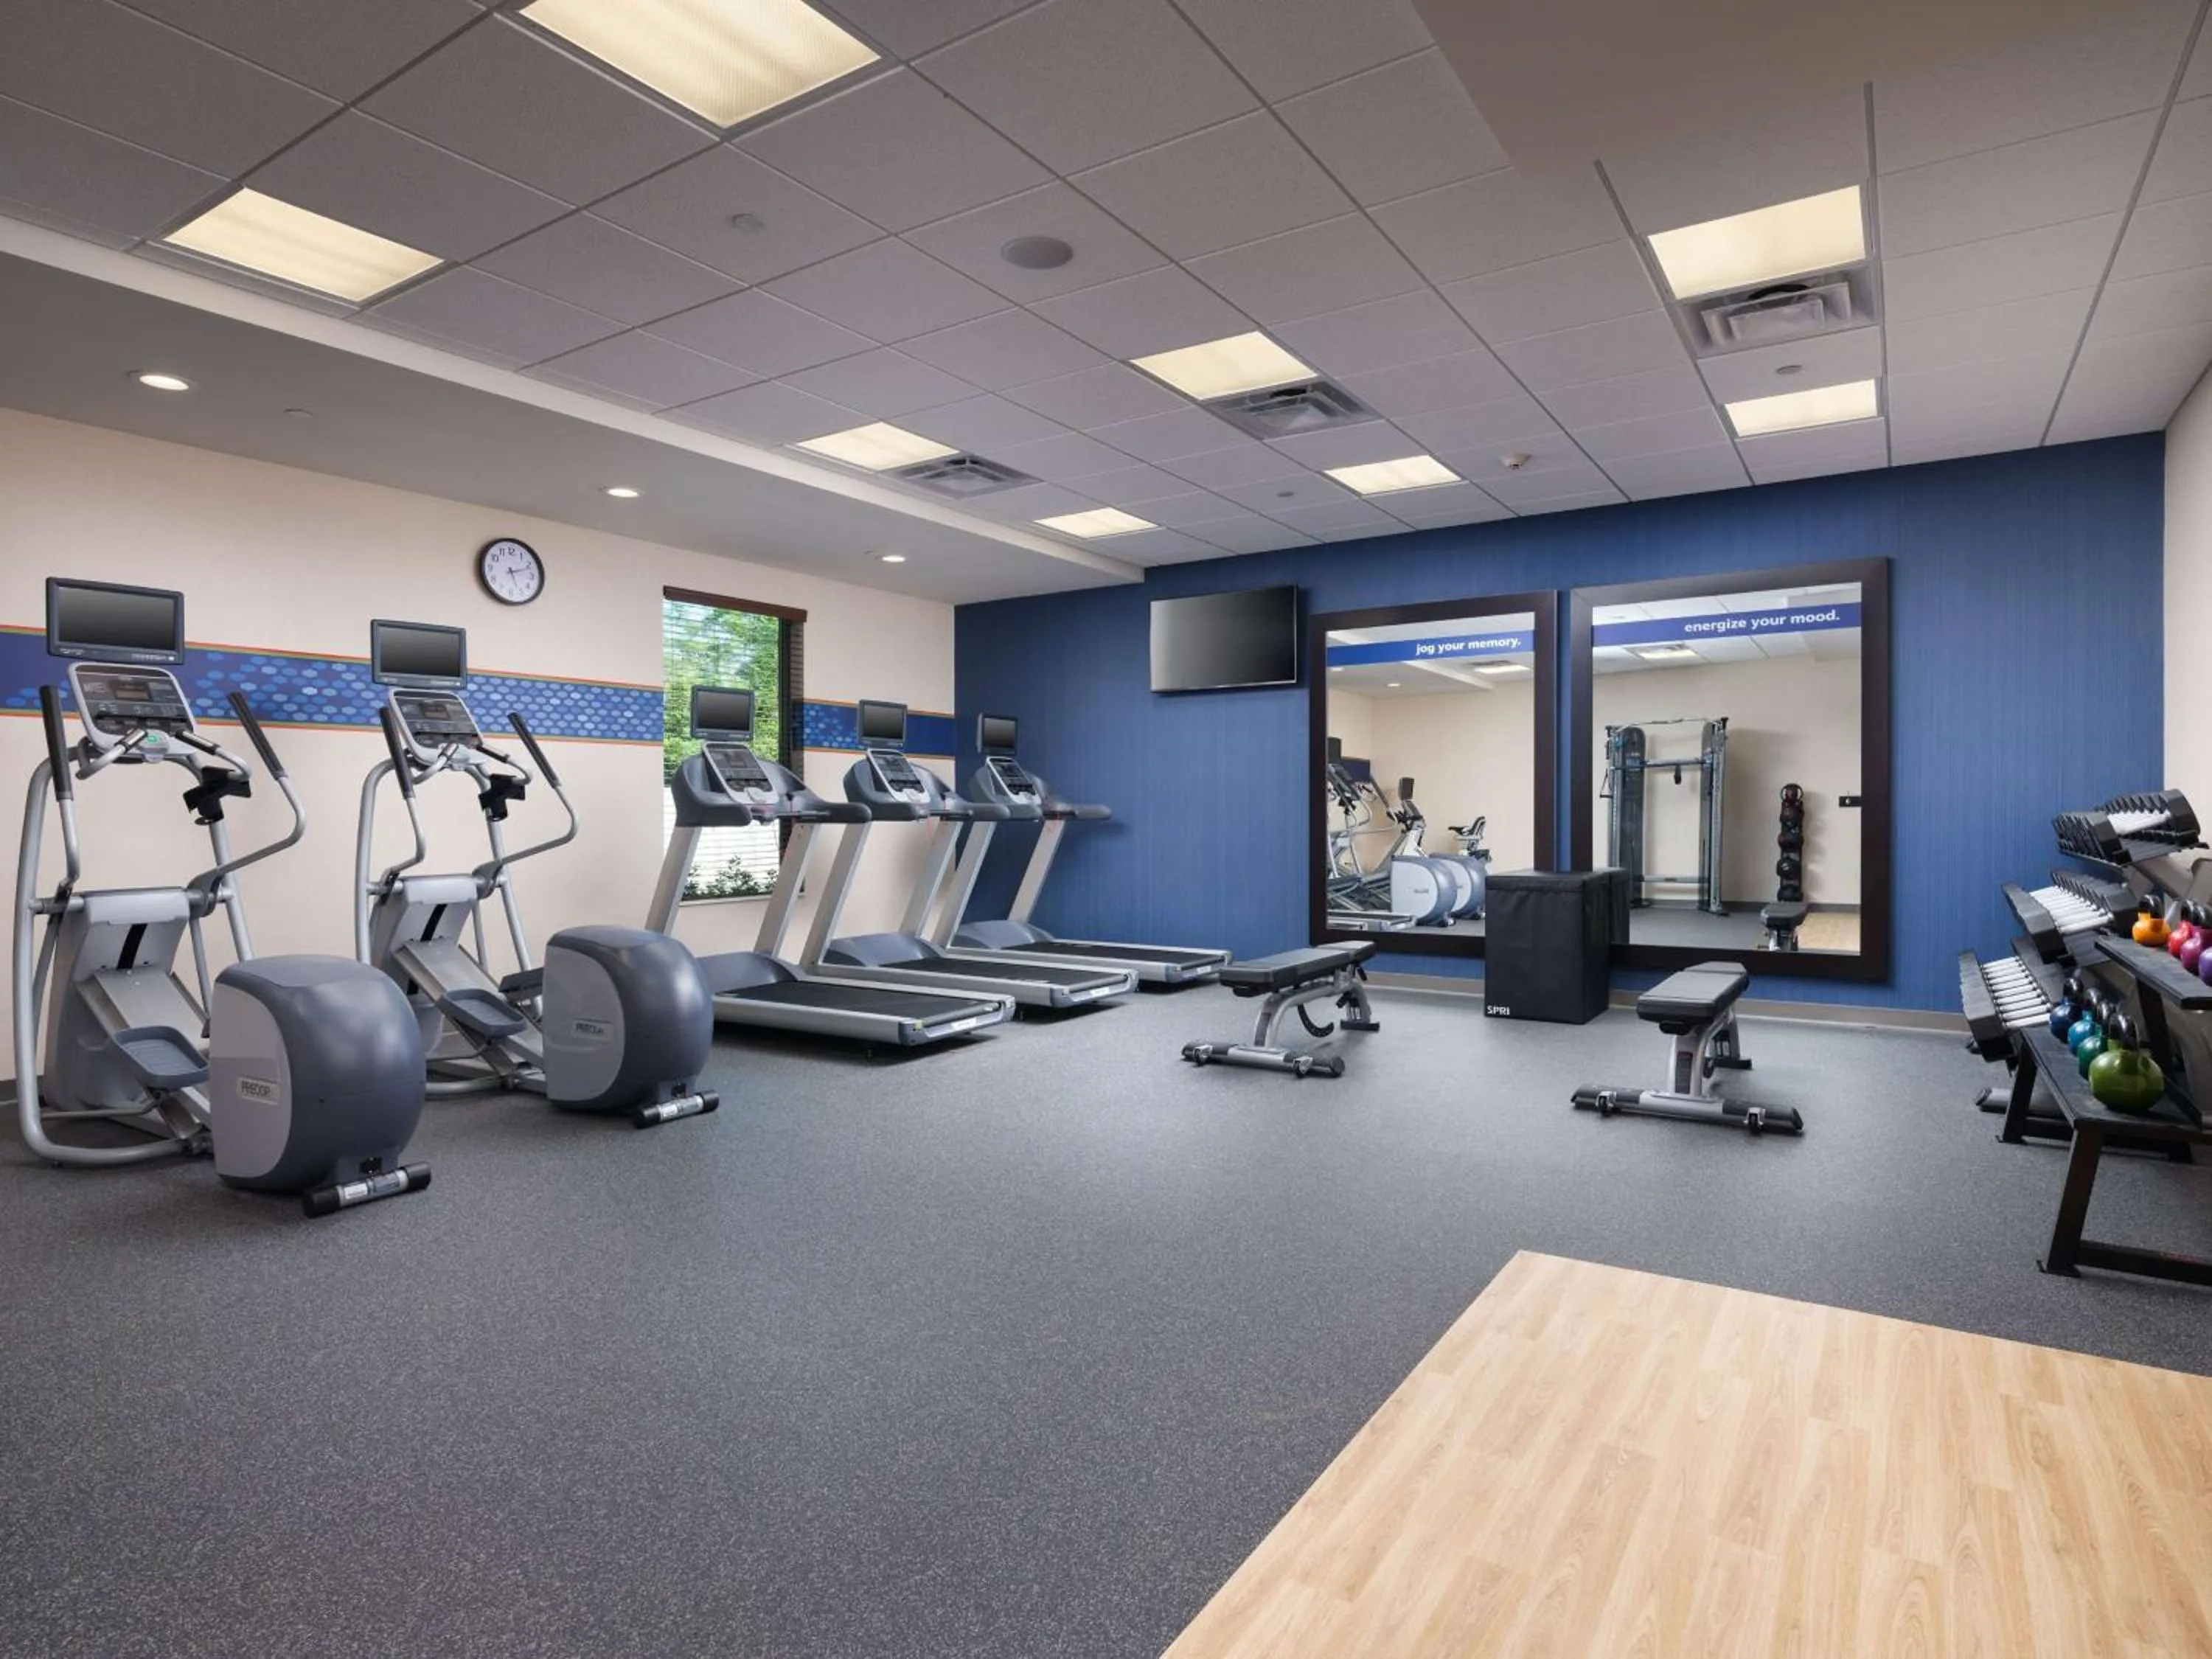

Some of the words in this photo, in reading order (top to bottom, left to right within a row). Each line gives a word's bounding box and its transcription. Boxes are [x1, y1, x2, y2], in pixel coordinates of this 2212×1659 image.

[1684, 618, 1747, 633] energize
[1751, 615, 1786, 630] your
[1790, 609, 1840, 624] mood.
[1416, 644, 1435, 655] jog
[1438, 642, 1464, 653] your
[1468, 637, 1522, 649] memory.
[1487, 1005, 1510, 1015] SPRI
